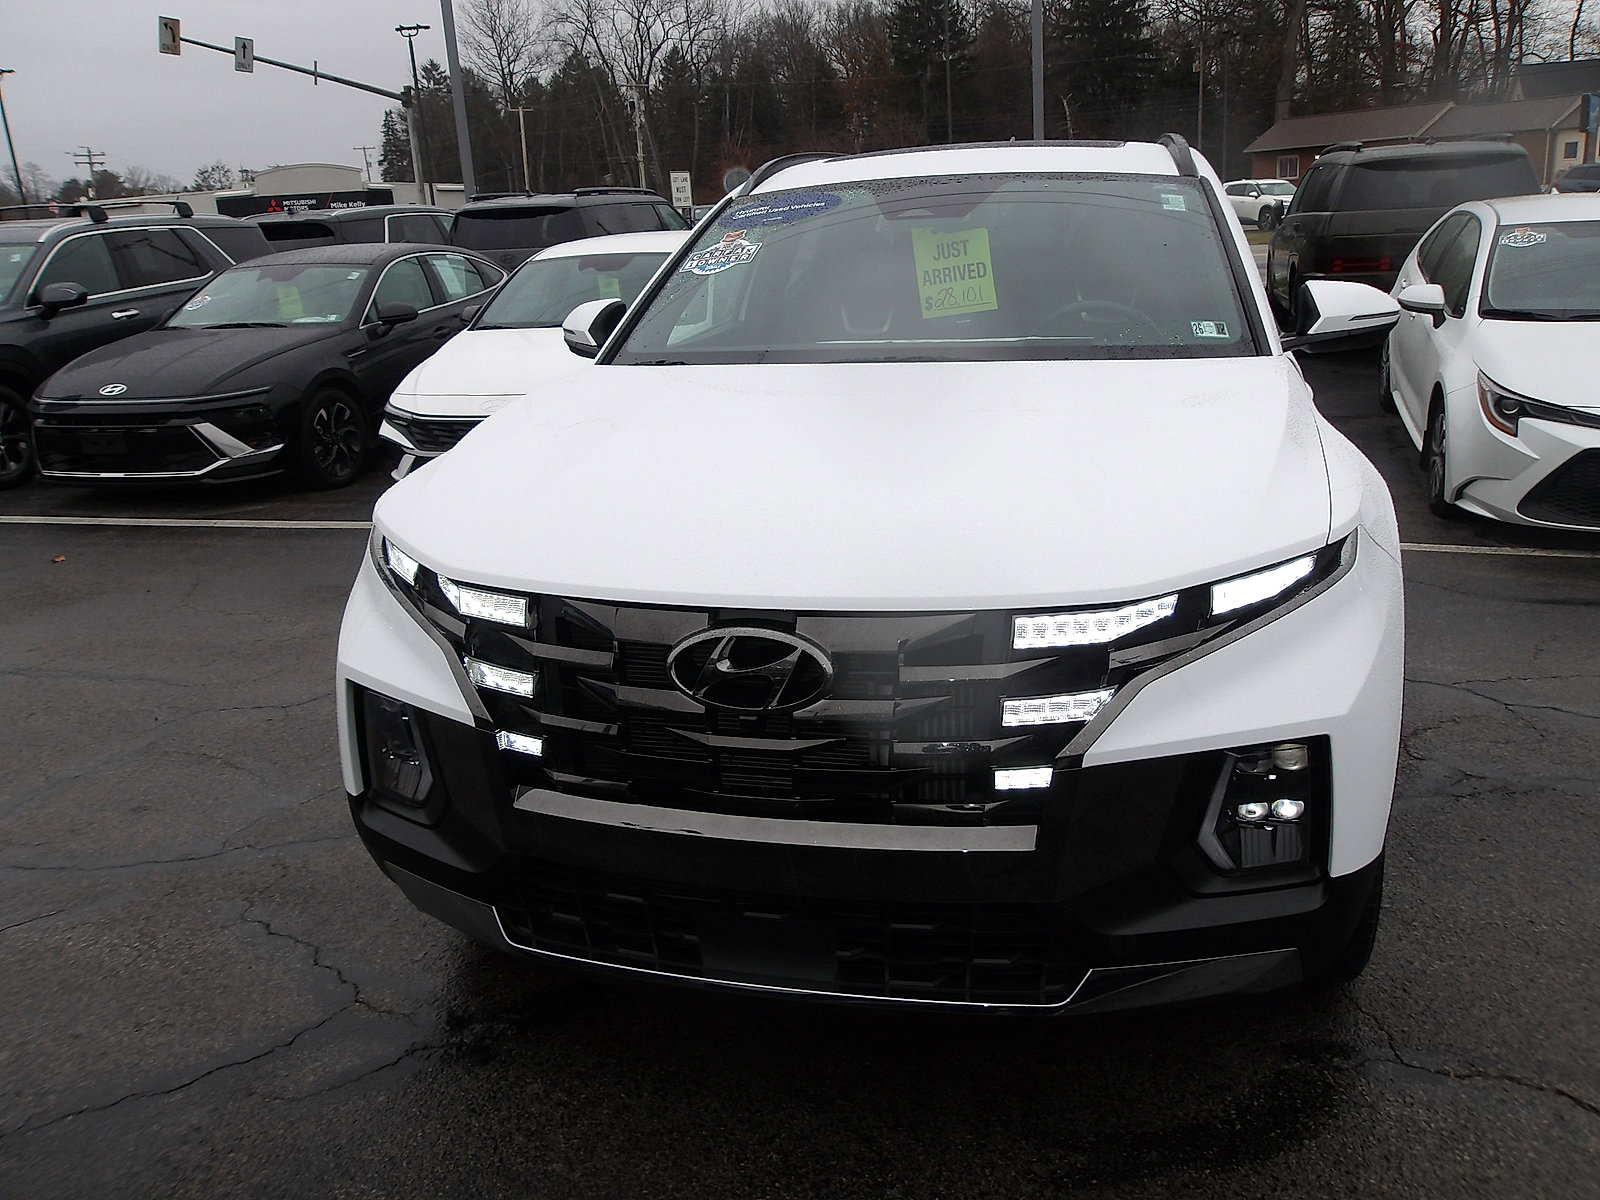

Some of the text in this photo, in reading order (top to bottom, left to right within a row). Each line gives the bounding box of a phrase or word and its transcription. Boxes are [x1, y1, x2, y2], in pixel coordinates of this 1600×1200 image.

[348, 200, 366, 208] Kelly
[732, 208, 770, 220] Certified
[768, 205, 790, 213] Used
[790, 201, 826, 210] Vehicles
[692, 246, 756, 261] CARFAX
[933, 240, 969, 261] JUST
[697, 254, 750, 267] OWNER
[923, 262, 987, 287] ARRIVED
[1192, 323, 1205, 335] 26
